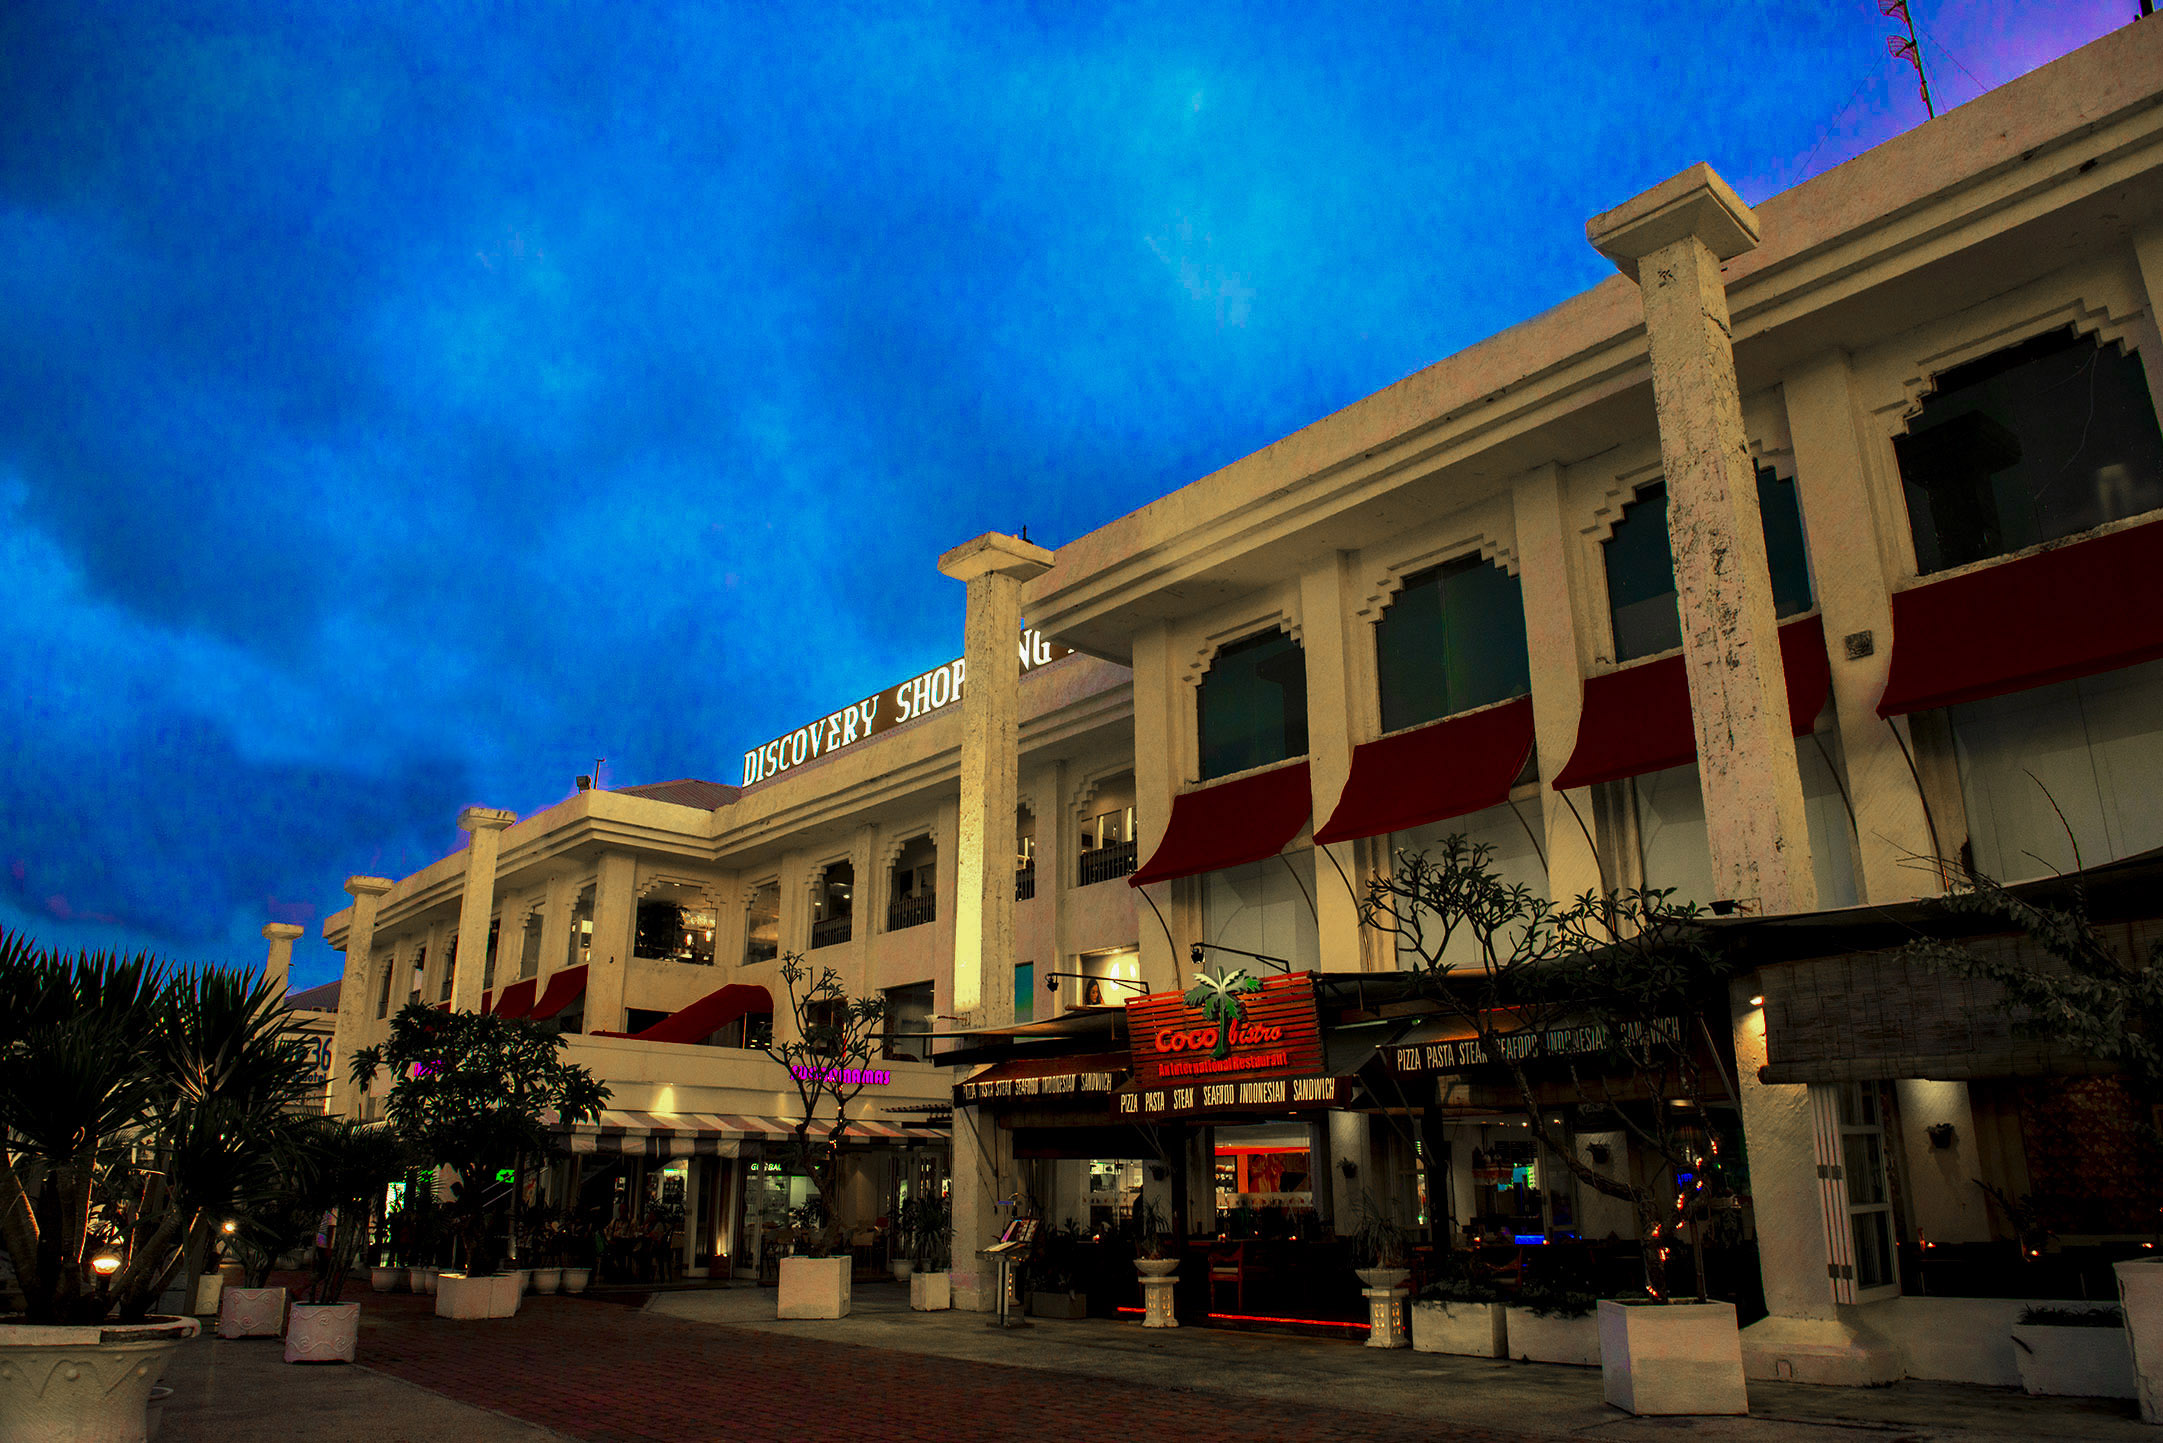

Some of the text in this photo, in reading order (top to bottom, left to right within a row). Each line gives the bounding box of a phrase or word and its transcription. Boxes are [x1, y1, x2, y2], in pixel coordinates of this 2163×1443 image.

[743, 695, 880, 788] DISCOVERY
[1155, 1017, 1283, 1053] Coco bistro
[1397, 1047, 1421, 1071] PIZZA
[1427, 1044, 1455, 1069] PASTA
[1015, 1077, 1039, 1095] SEAFOOD
[1081, 1072, 1112, 1092] SANDWICH
[1120, 1077, 1335, 1114] PIZZA PASTA STEAK SEAFOOD INDONESIAN SANDWICH
